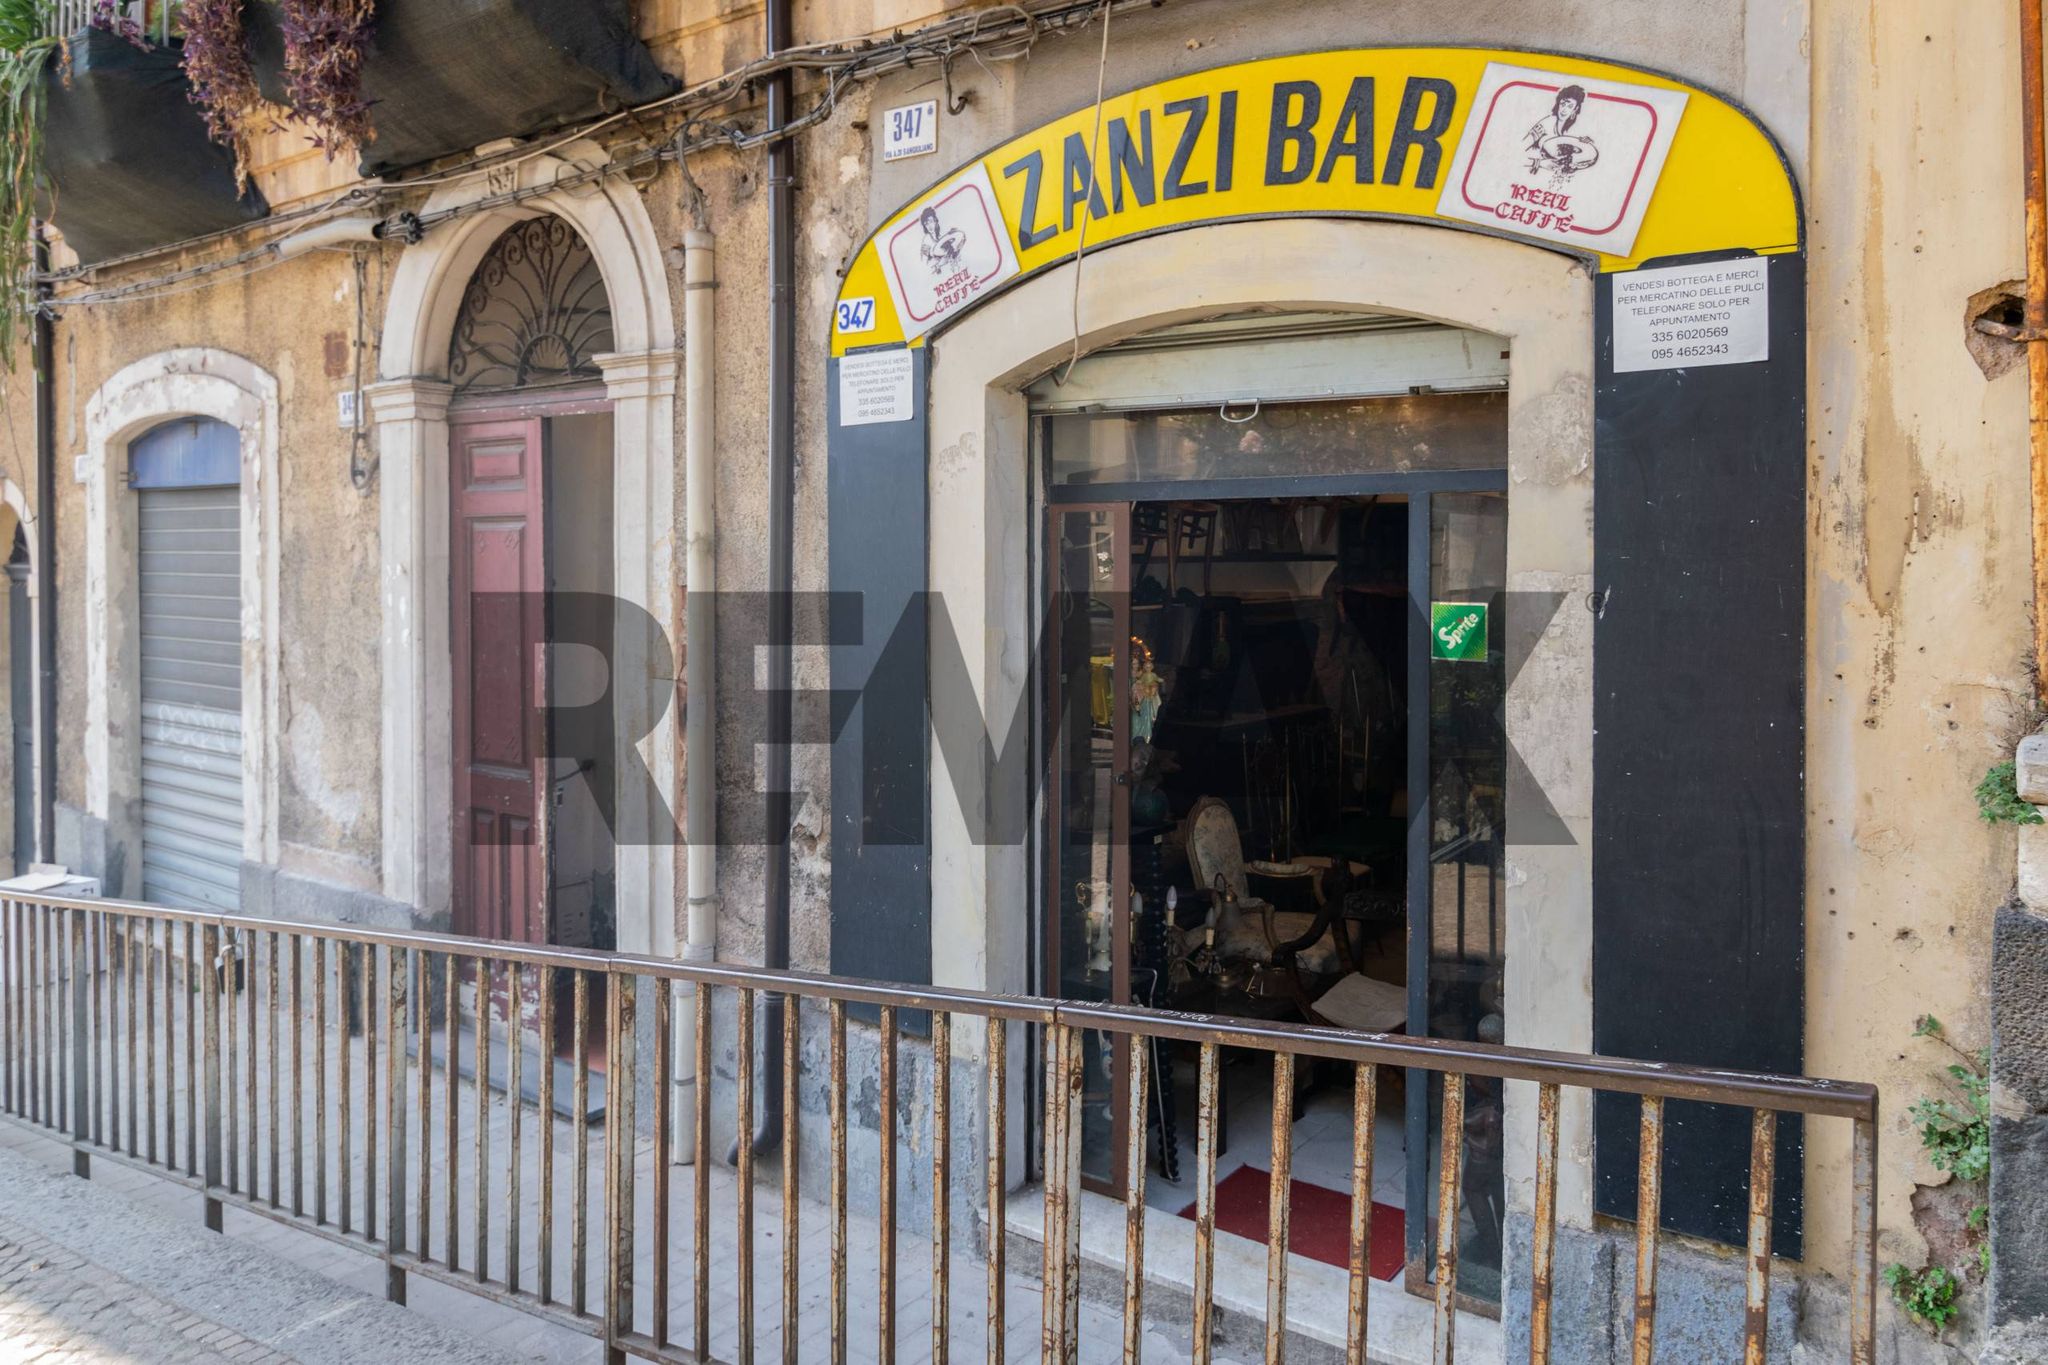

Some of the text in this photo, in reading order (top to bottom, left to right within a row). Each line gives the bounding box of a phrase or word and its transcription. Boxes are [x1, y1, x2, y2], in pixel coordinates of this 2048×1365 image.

[893, 107, 922, 141] 347
[1003, 76, 1457, 251] ZANZI BAR
[1510, 183, 1571, 211] REAL
[933, 268, 972, 297] REAL
[1617, 282, 1765, 305] PER MERCATINO DELLE PULCI
[1622, 269, 1760, 293] VENDESI BOTTEGA E MERCI
[838, 300, 873, 330] 347
[1632, 296, 1750, 317] TELEFONARE SOLO PER
[1649, 311, 1731, 328] APPUNTAMENTO
[1651, 326, 1729, 343] 335 6020569
[1651, 343, 1729, 360] 095 4652343
[1438, 613, 1479, 650] Sprite
